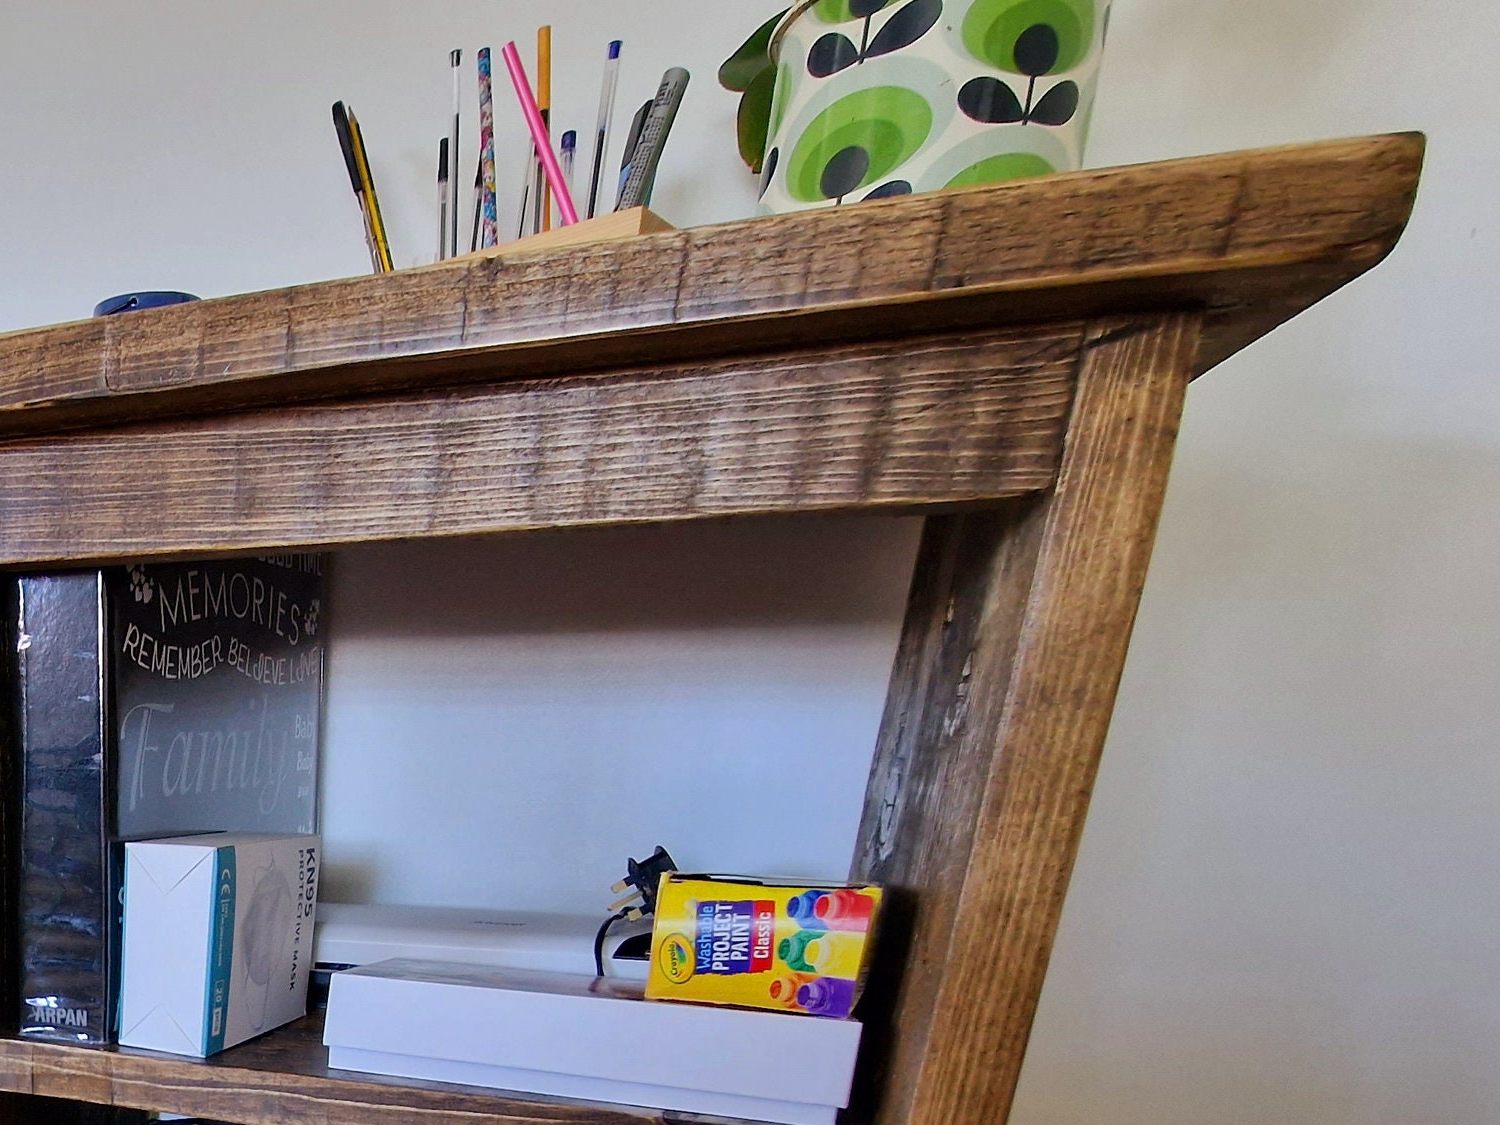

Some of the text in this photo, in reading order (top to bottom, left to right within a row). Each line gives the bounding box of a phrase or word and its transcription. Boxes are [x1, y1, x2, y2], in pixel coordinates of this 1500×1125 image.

[158, 570, 301, 646] MEMORIES
[122, 622, 224, 680] REMEMBER
[227, 636, 287, 685] BELIEVE
[120, 694, 288, 815] Family
[304, 847, 316, 918] KN95
[289, 849, 305, 992] PROTECTIVE MASK
[696, 905, 714, 970] Washable
[711, 903, 733, 971] PROJECT
[730, 912, 751, 961] PAINT
[753, 911, 772, 959] Classic
[668, 943, 679, 977] Crayola
[34, 1007, 88, 1027] ARPAN
